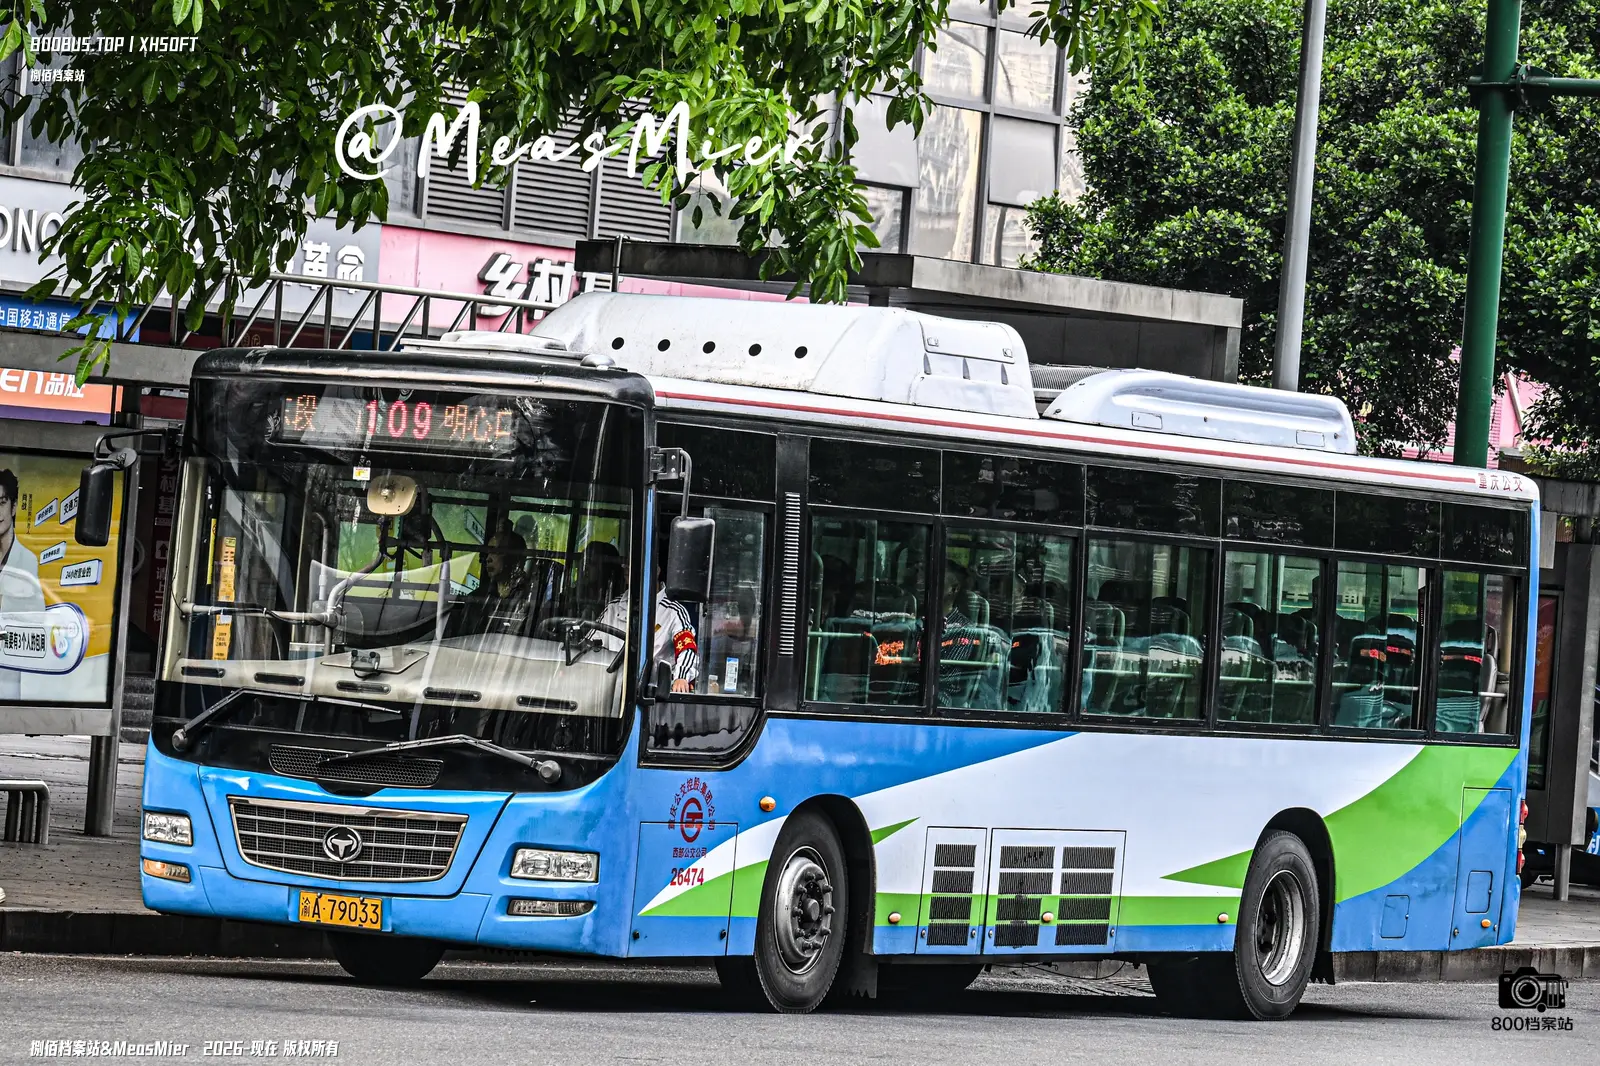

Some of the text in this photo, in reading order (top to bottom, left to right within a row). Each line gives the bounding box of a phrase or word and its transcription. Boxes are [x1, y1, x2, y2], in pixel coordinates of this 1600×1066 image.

[366, 400, 432, 439] 109
[1478, 473, 1523, 491] 重庆公交
[672, 847, 707, 858] 西部公交公司
[670, 868, 704, 886] 26474
